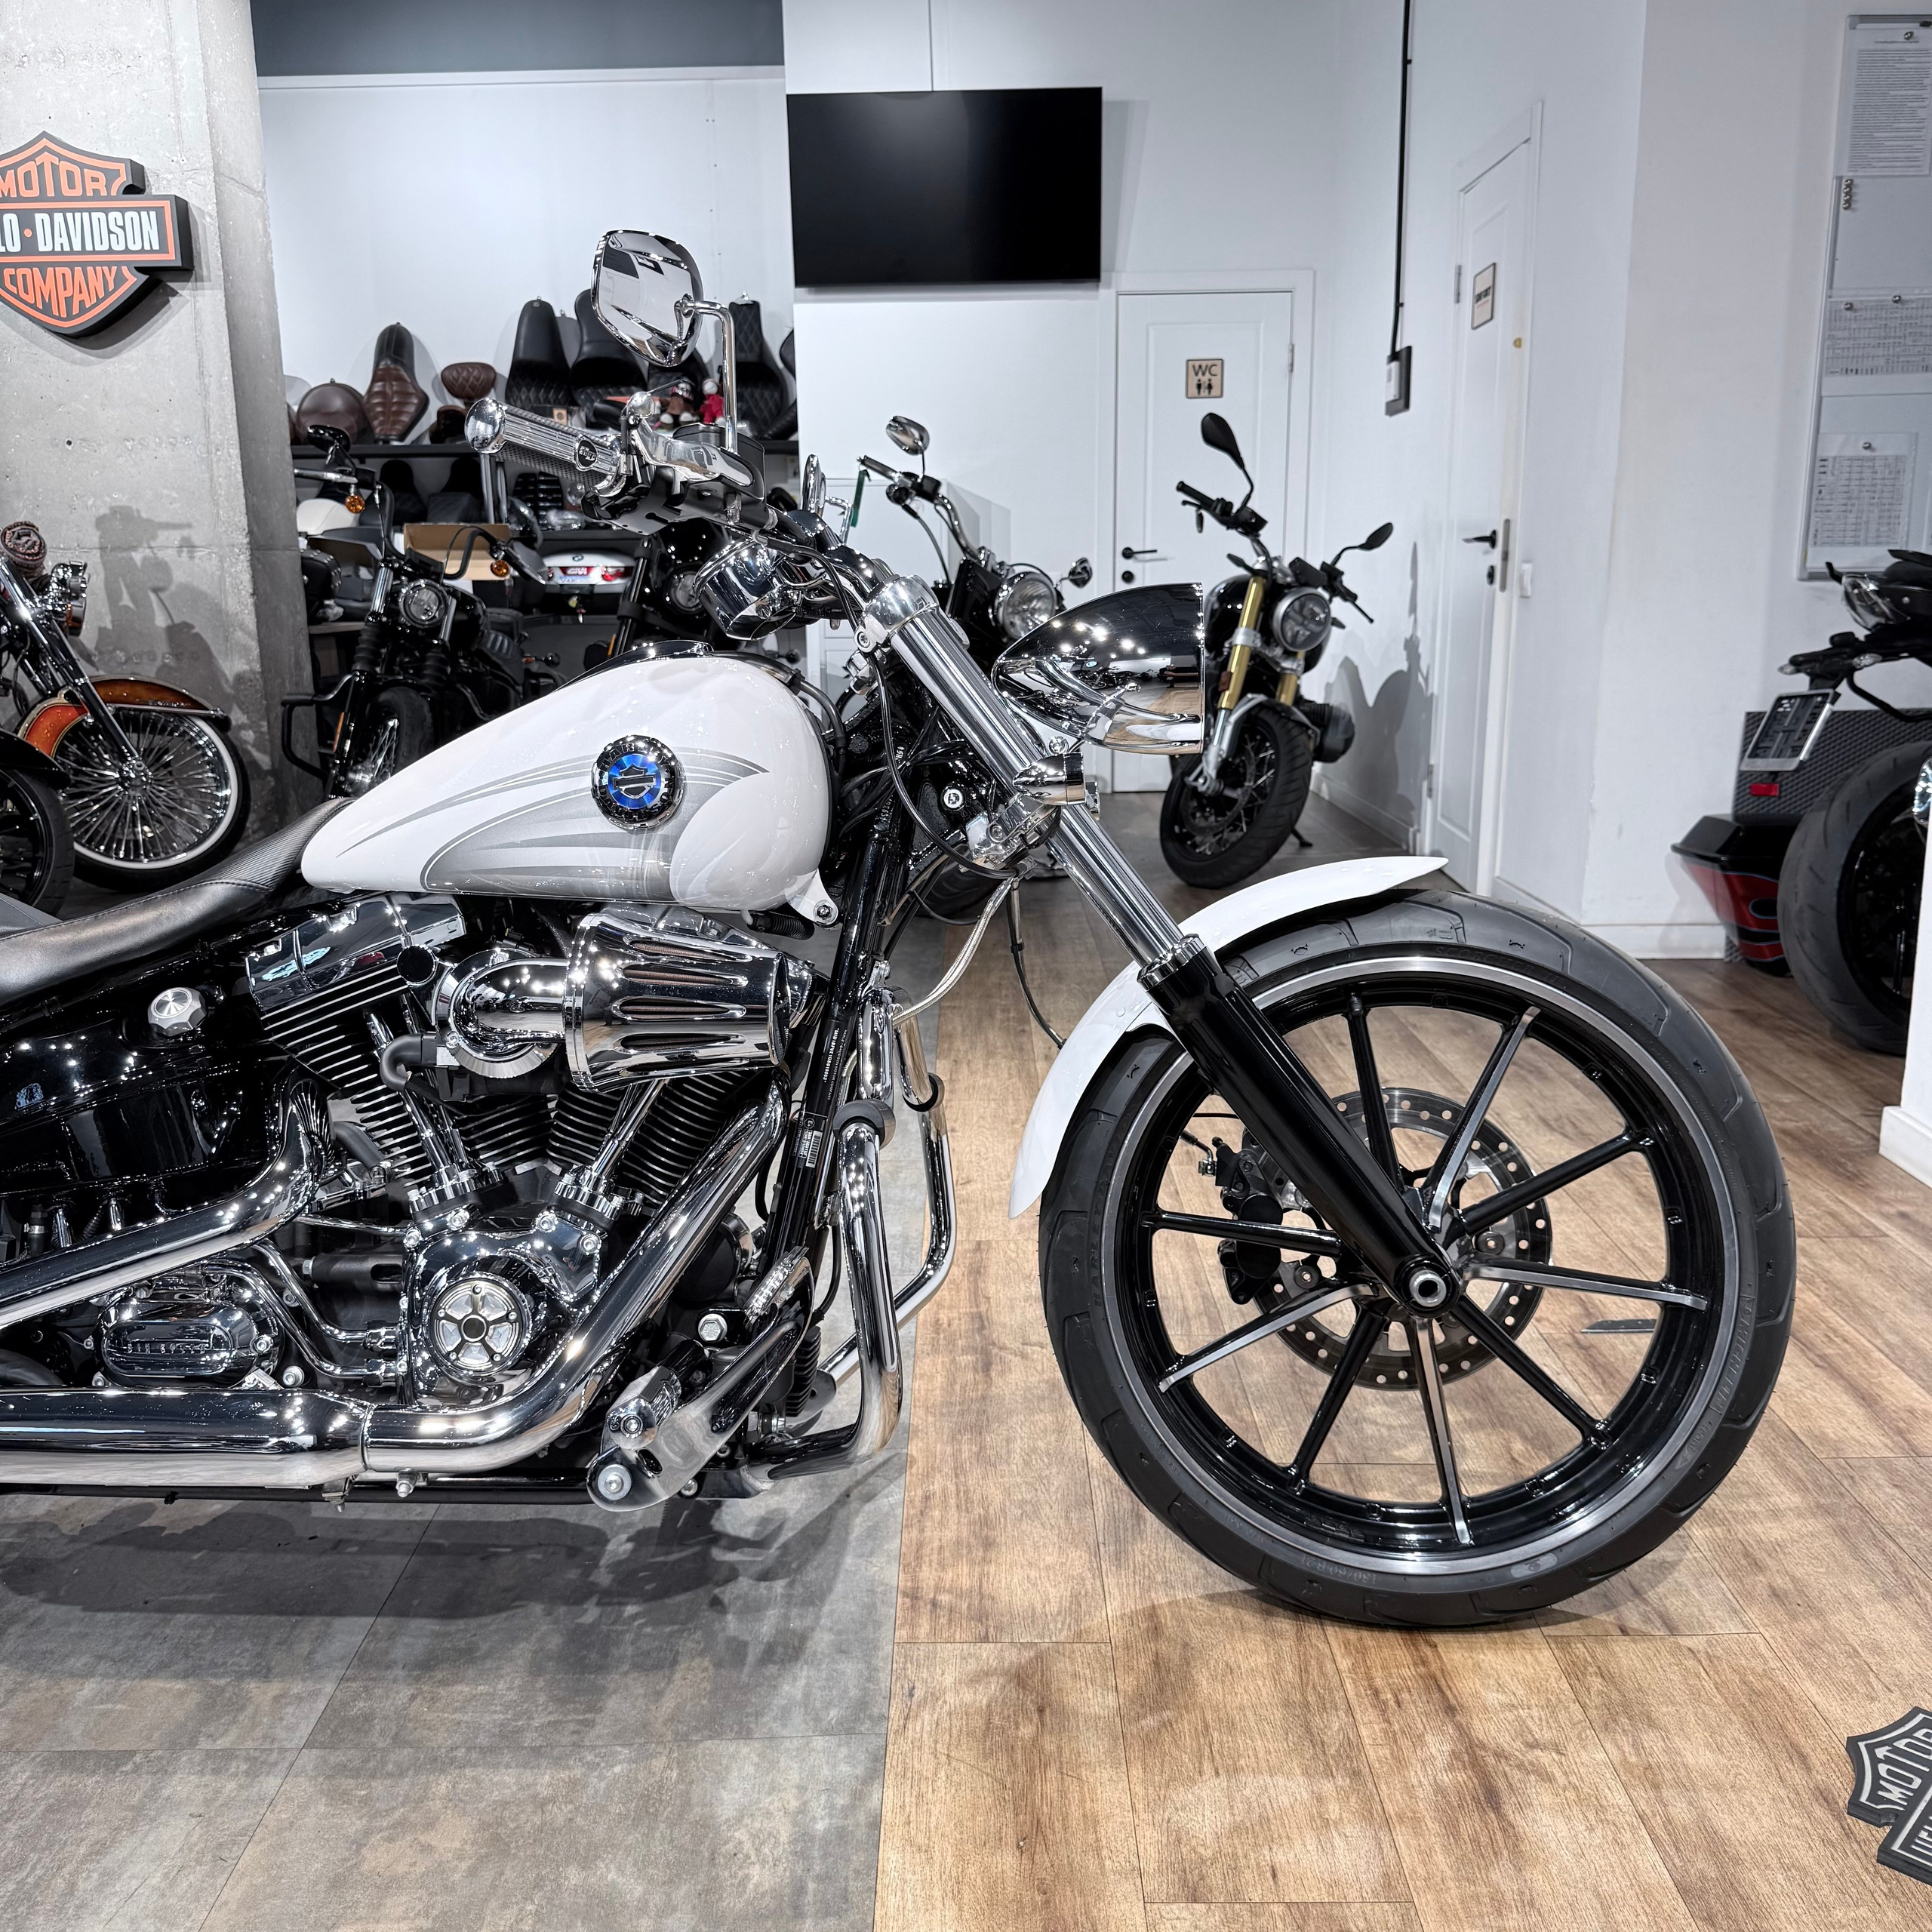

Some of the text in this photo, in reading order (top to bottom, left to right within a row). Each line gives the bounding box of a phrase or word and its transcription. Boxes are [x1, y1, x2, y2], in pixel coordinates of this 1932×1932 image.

[0, 152, 107, 198] MOTOR
[35, 211, 160, 252] DAVIDSON
[3, 266, 118, 318] COMPANY
[1192, 364, 1217, 377] WC
